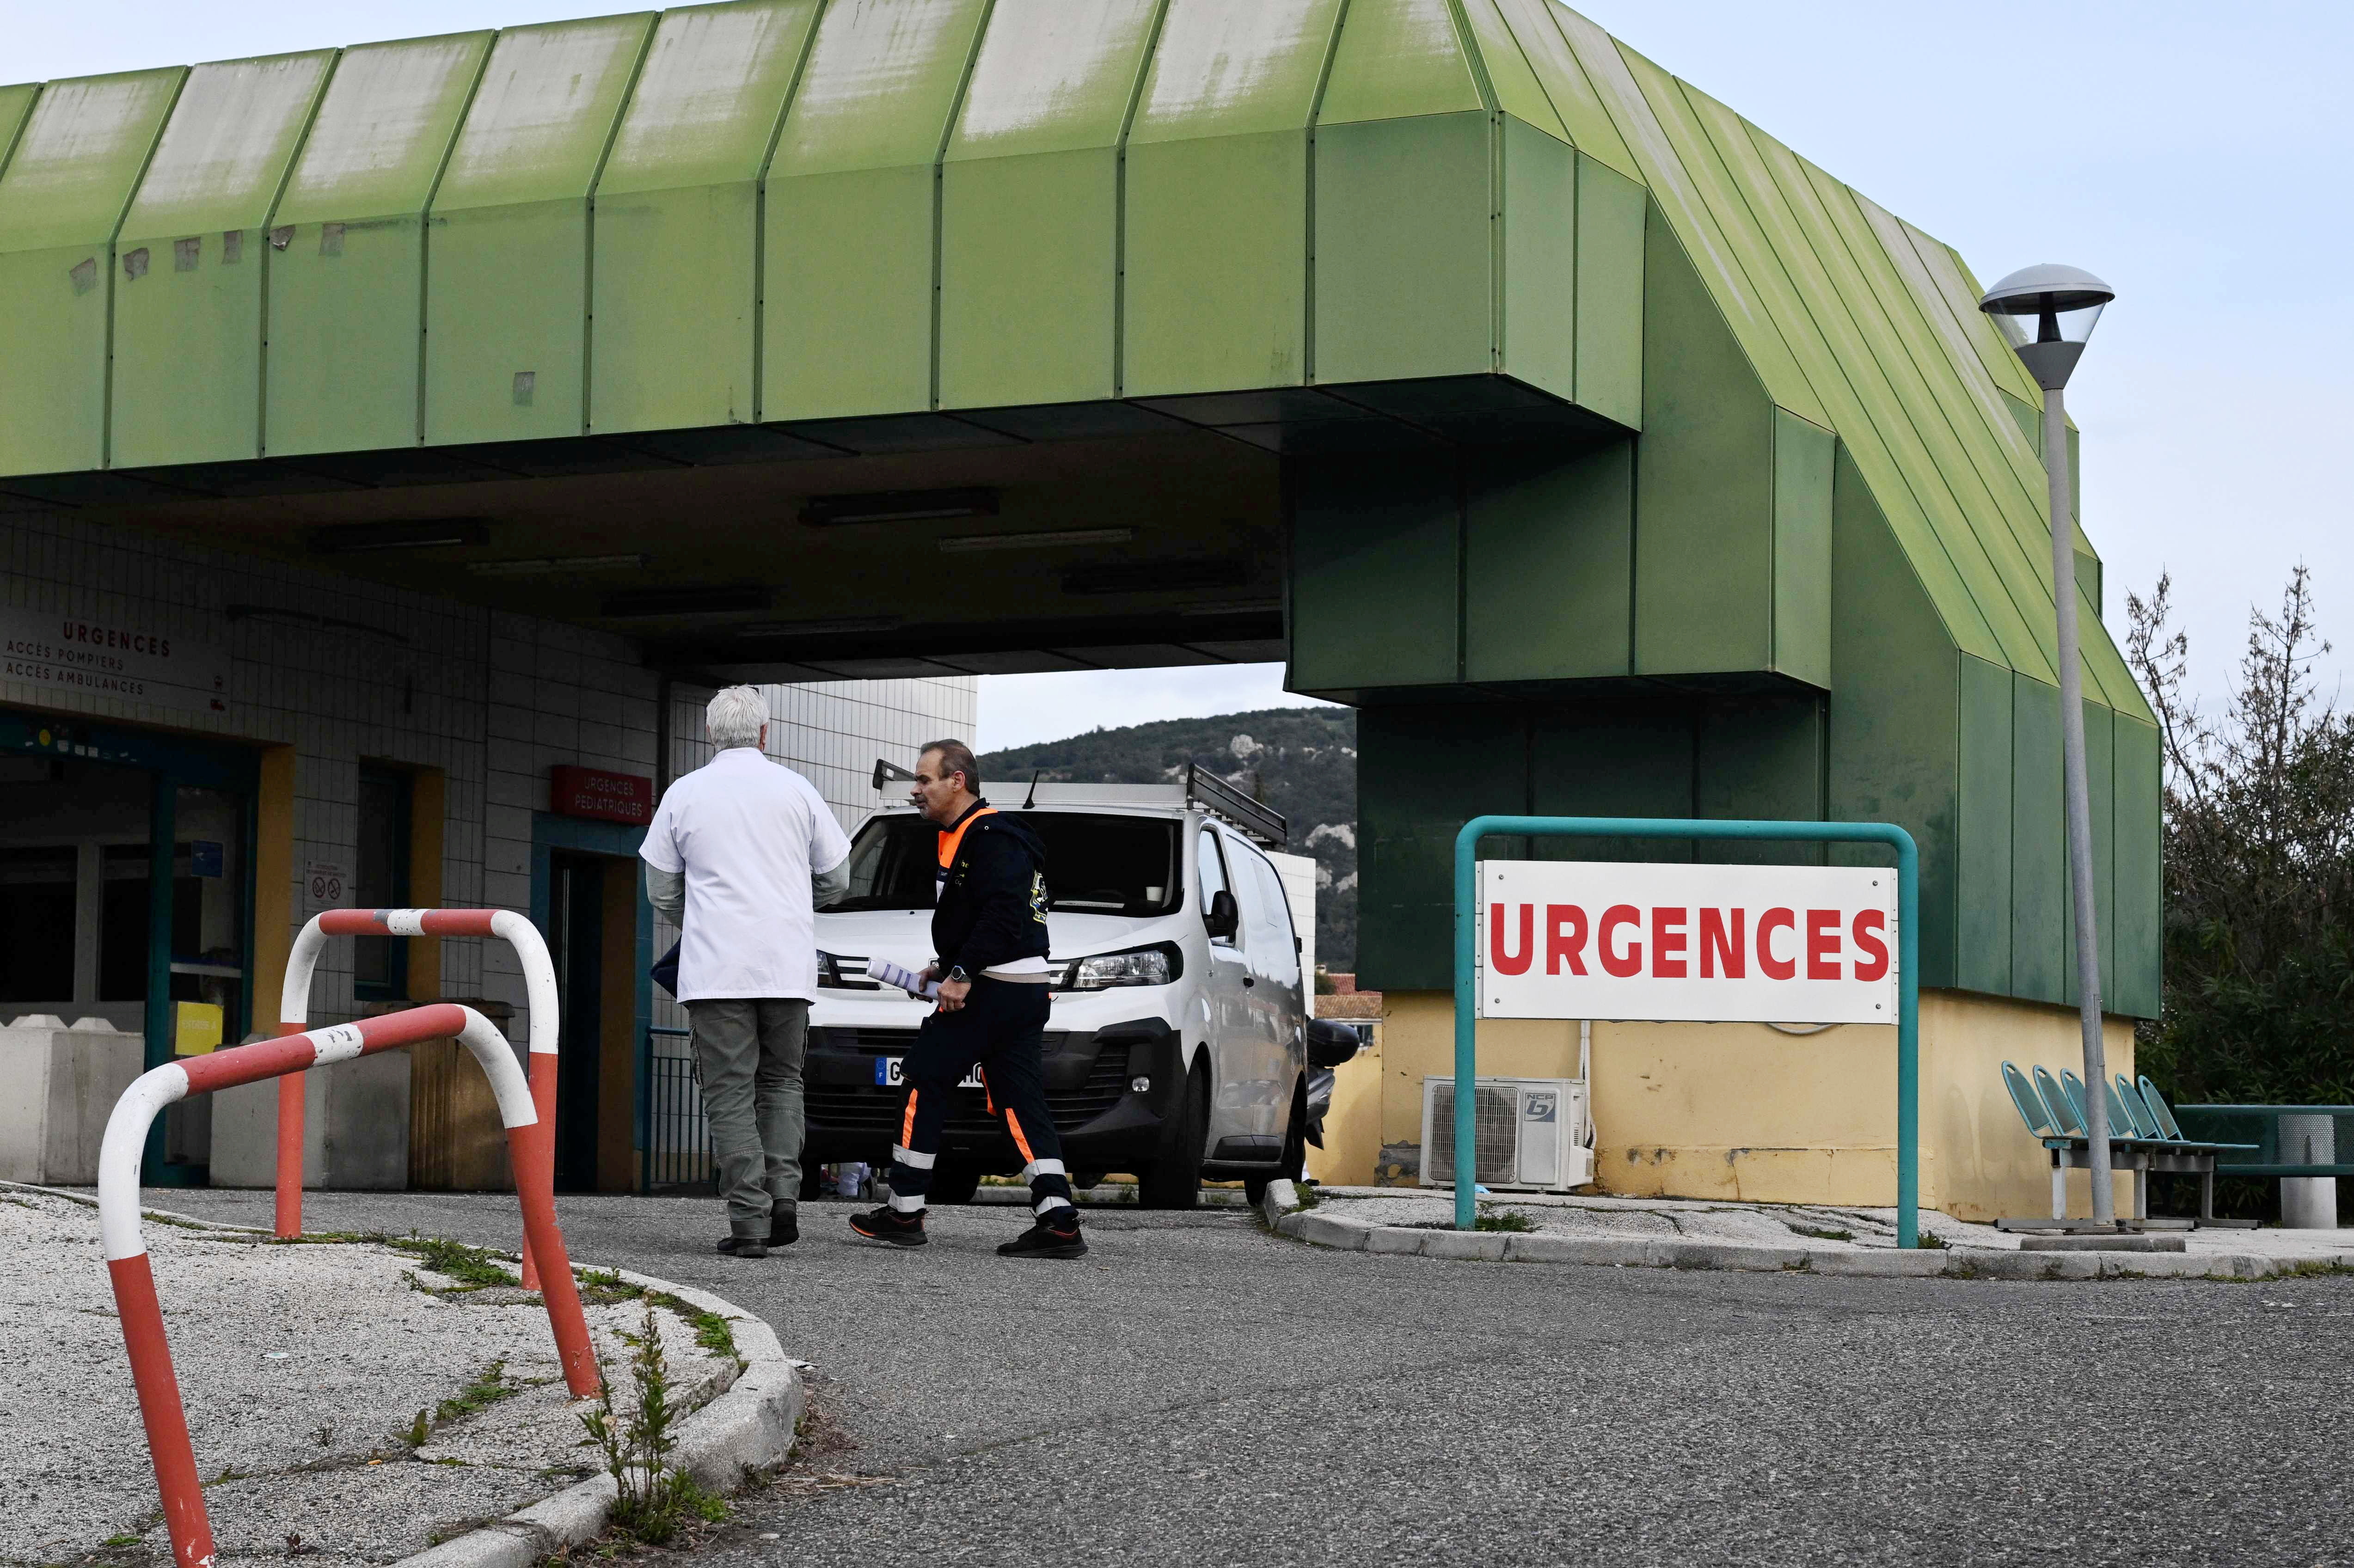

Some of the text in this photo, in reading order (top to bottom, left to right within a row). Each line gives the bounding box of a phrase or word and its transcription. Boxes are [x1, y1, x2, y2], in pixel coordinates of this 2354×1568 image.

[63, 622, 170, 657] URGENCES
[58, 648, 123, 671] POMPIERS
[57, 670, 144, 695] AMBULANCES
[584, 776, 634, 796] URGENCES
[1490, 902, 1889, 982] URGENCES
